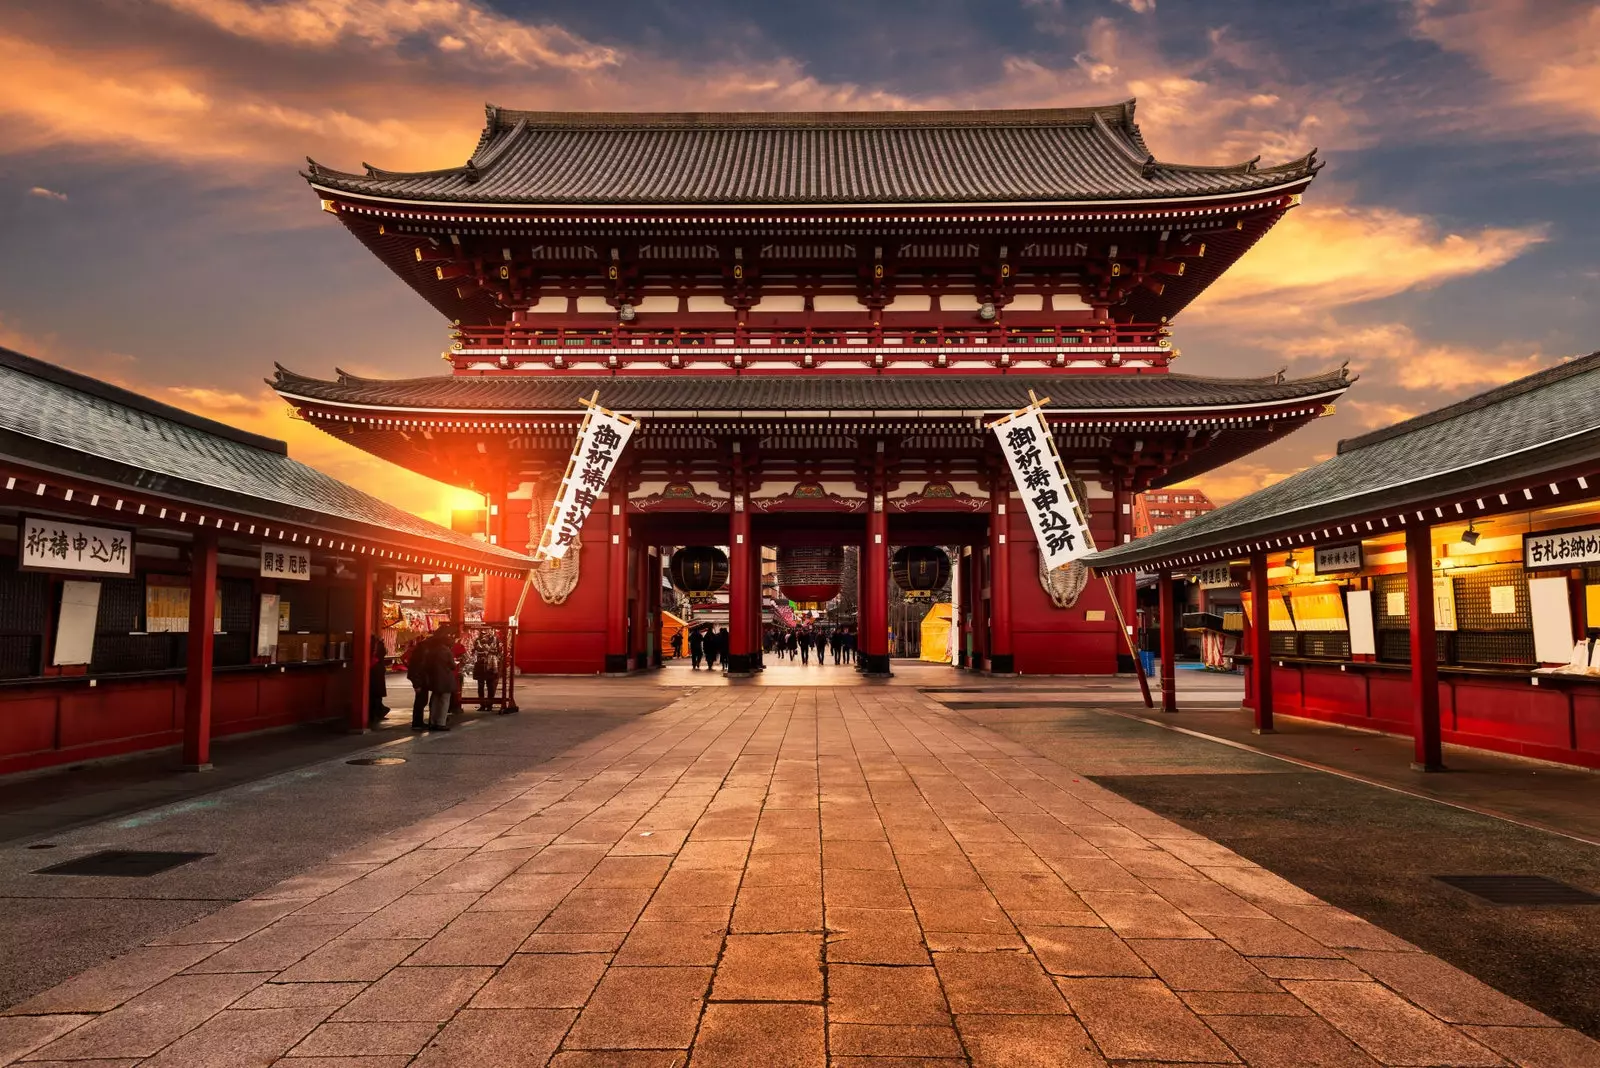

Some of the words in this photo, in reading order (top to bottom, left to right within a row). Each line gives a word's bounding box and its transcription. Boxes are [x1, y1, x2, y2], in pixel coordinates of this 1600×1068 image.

[1006, 425, 1076, 556] 御祈祷申込所
[1531, 534, 1600, 562] 古札お納め
